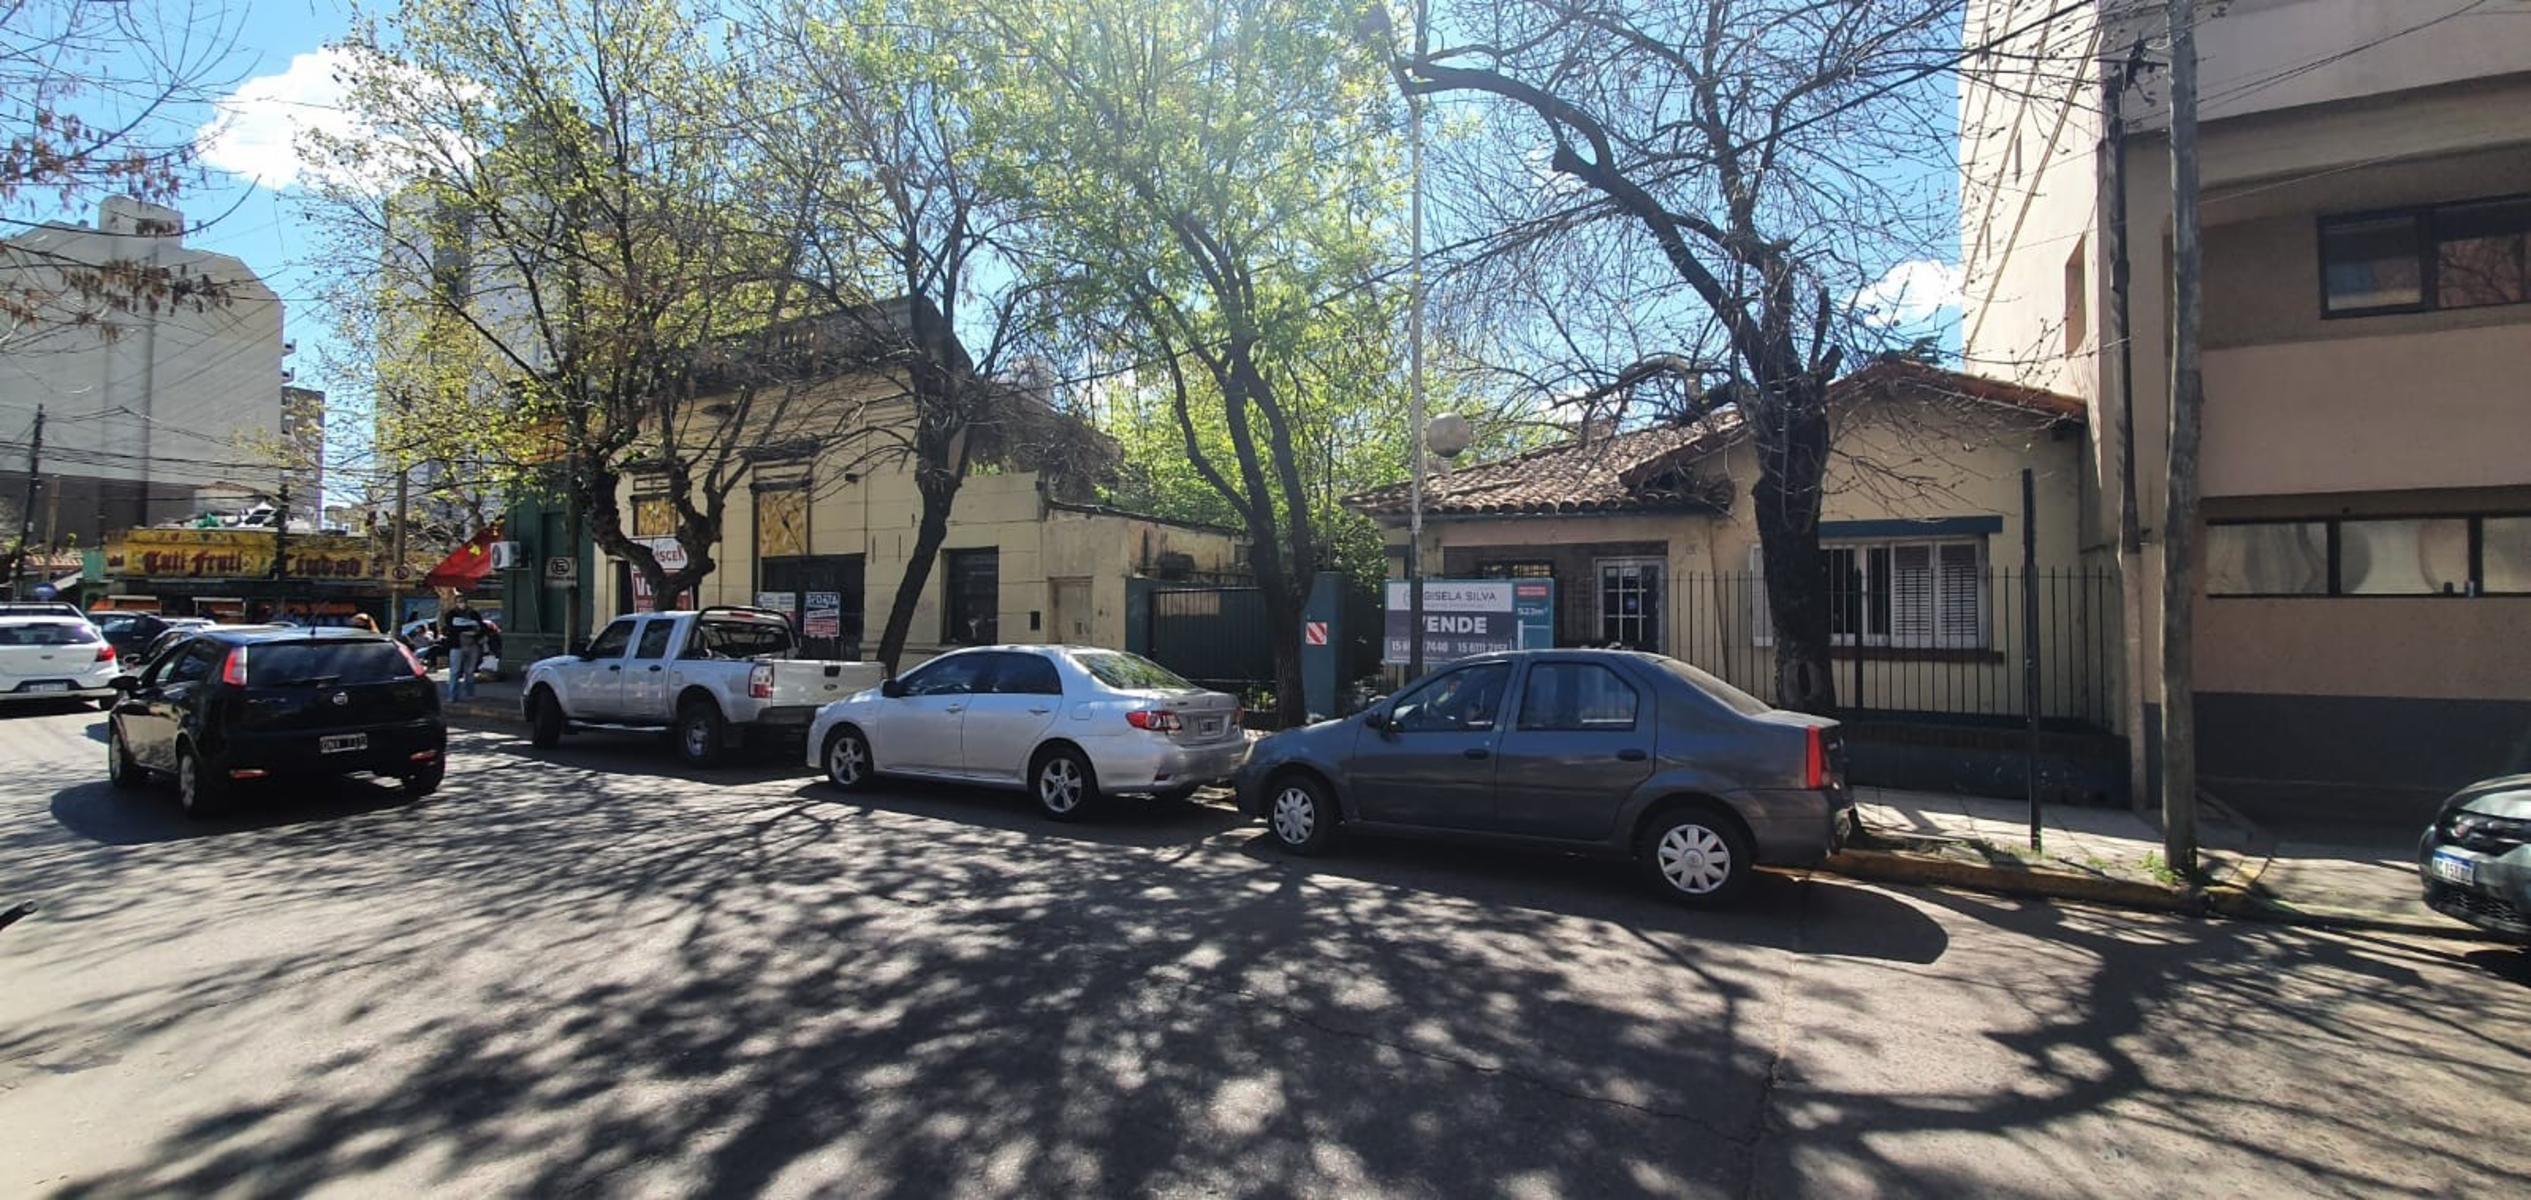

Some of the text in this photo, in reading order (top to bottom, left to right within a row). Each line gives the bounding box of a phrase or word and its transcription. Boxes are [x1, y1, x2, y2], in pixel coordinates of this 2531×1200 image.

[1424, 591, 1497, 601] GISELA SILVA
[1423, 615, 1488, 634] ENDE
